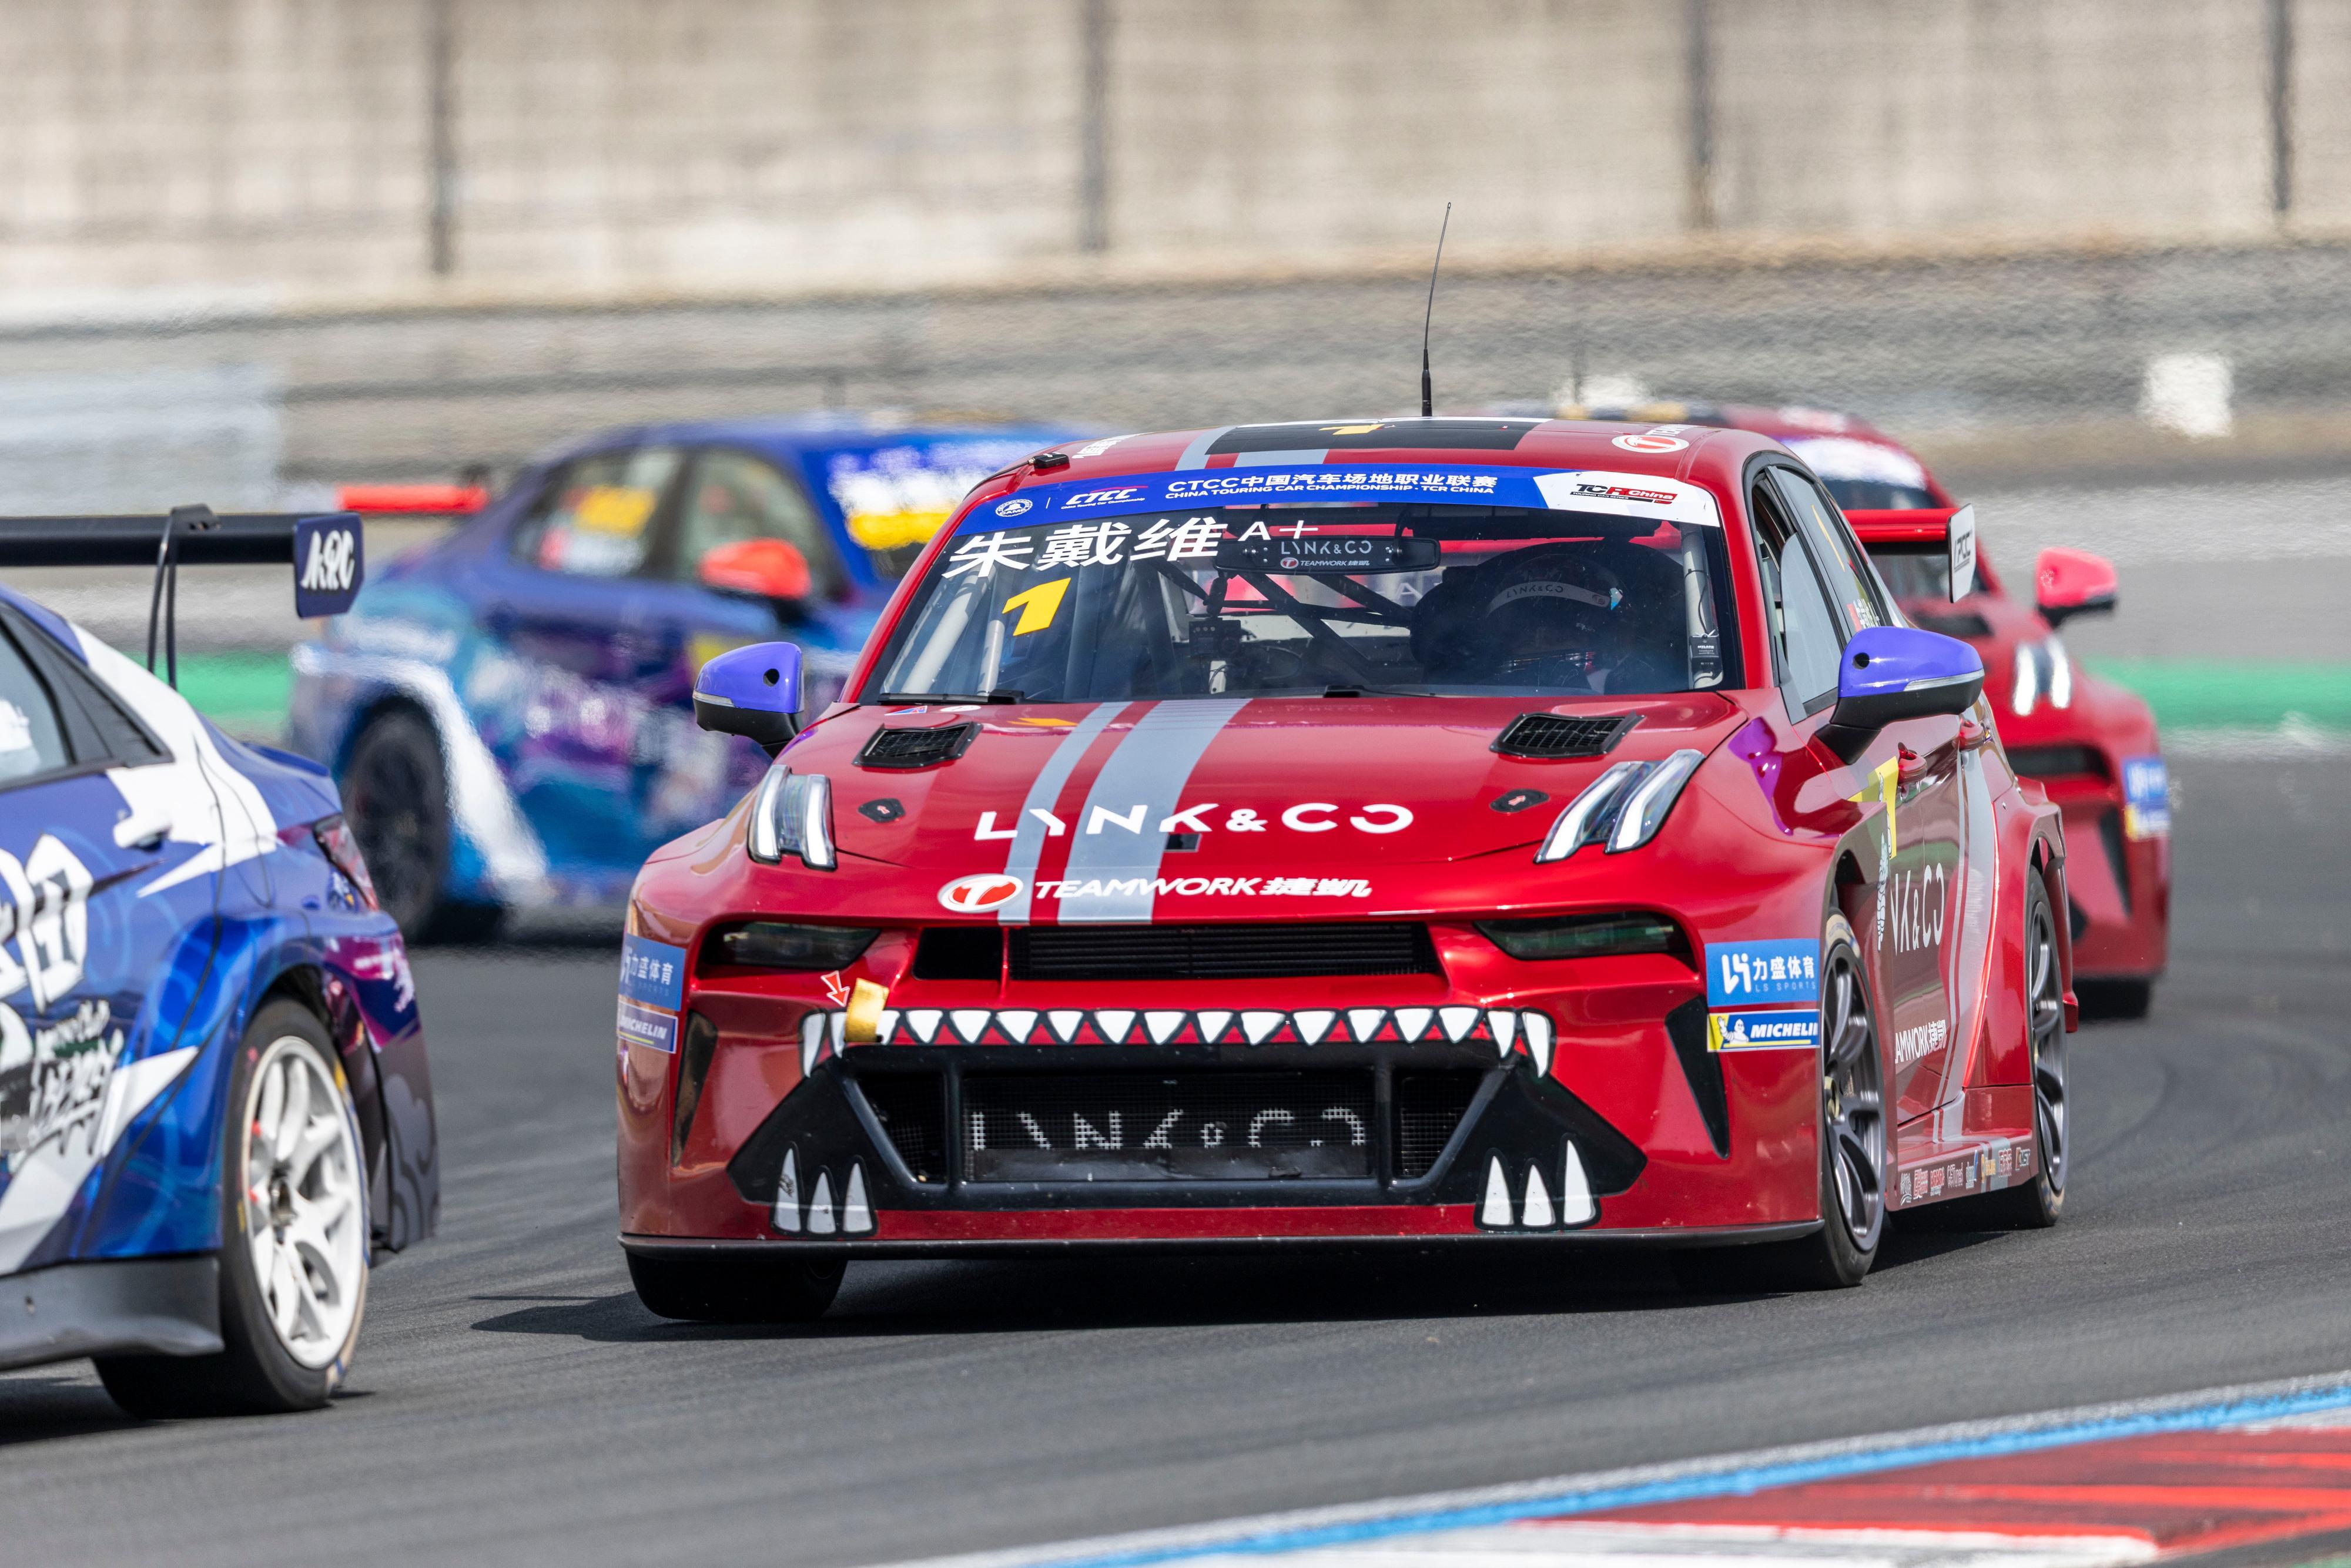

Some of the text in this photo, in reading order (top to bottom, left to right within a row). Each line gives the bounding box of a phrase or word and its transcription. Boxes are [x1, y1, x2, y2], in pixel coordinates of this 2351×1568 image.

[1165, 490, 1208, 499] CHINA
[1211, 485, 1272, 495] TOURING
[1168, 473, 1498, 492] CTCC中国汽车场地职业联赛
[1576, 483, 1673, 500] TCR China
[1066, 488, 1138, 505] CTCC
[942, 517, 1318, 580] 朱戴维 A+
[1280, 540, 1372, 555] LYNK&CO
[1002, 577, 1071, 636] 1
[974, 803, 1414, 840] LYNK&CO
[1035, 877, 1262, 900] TEAMWORK
[1753, 955, 1815, 981] 力盛体育
[1754, 981, 1816, 993] LS SPORTS
[620, 1016, 668, 1040] MICHELIN
